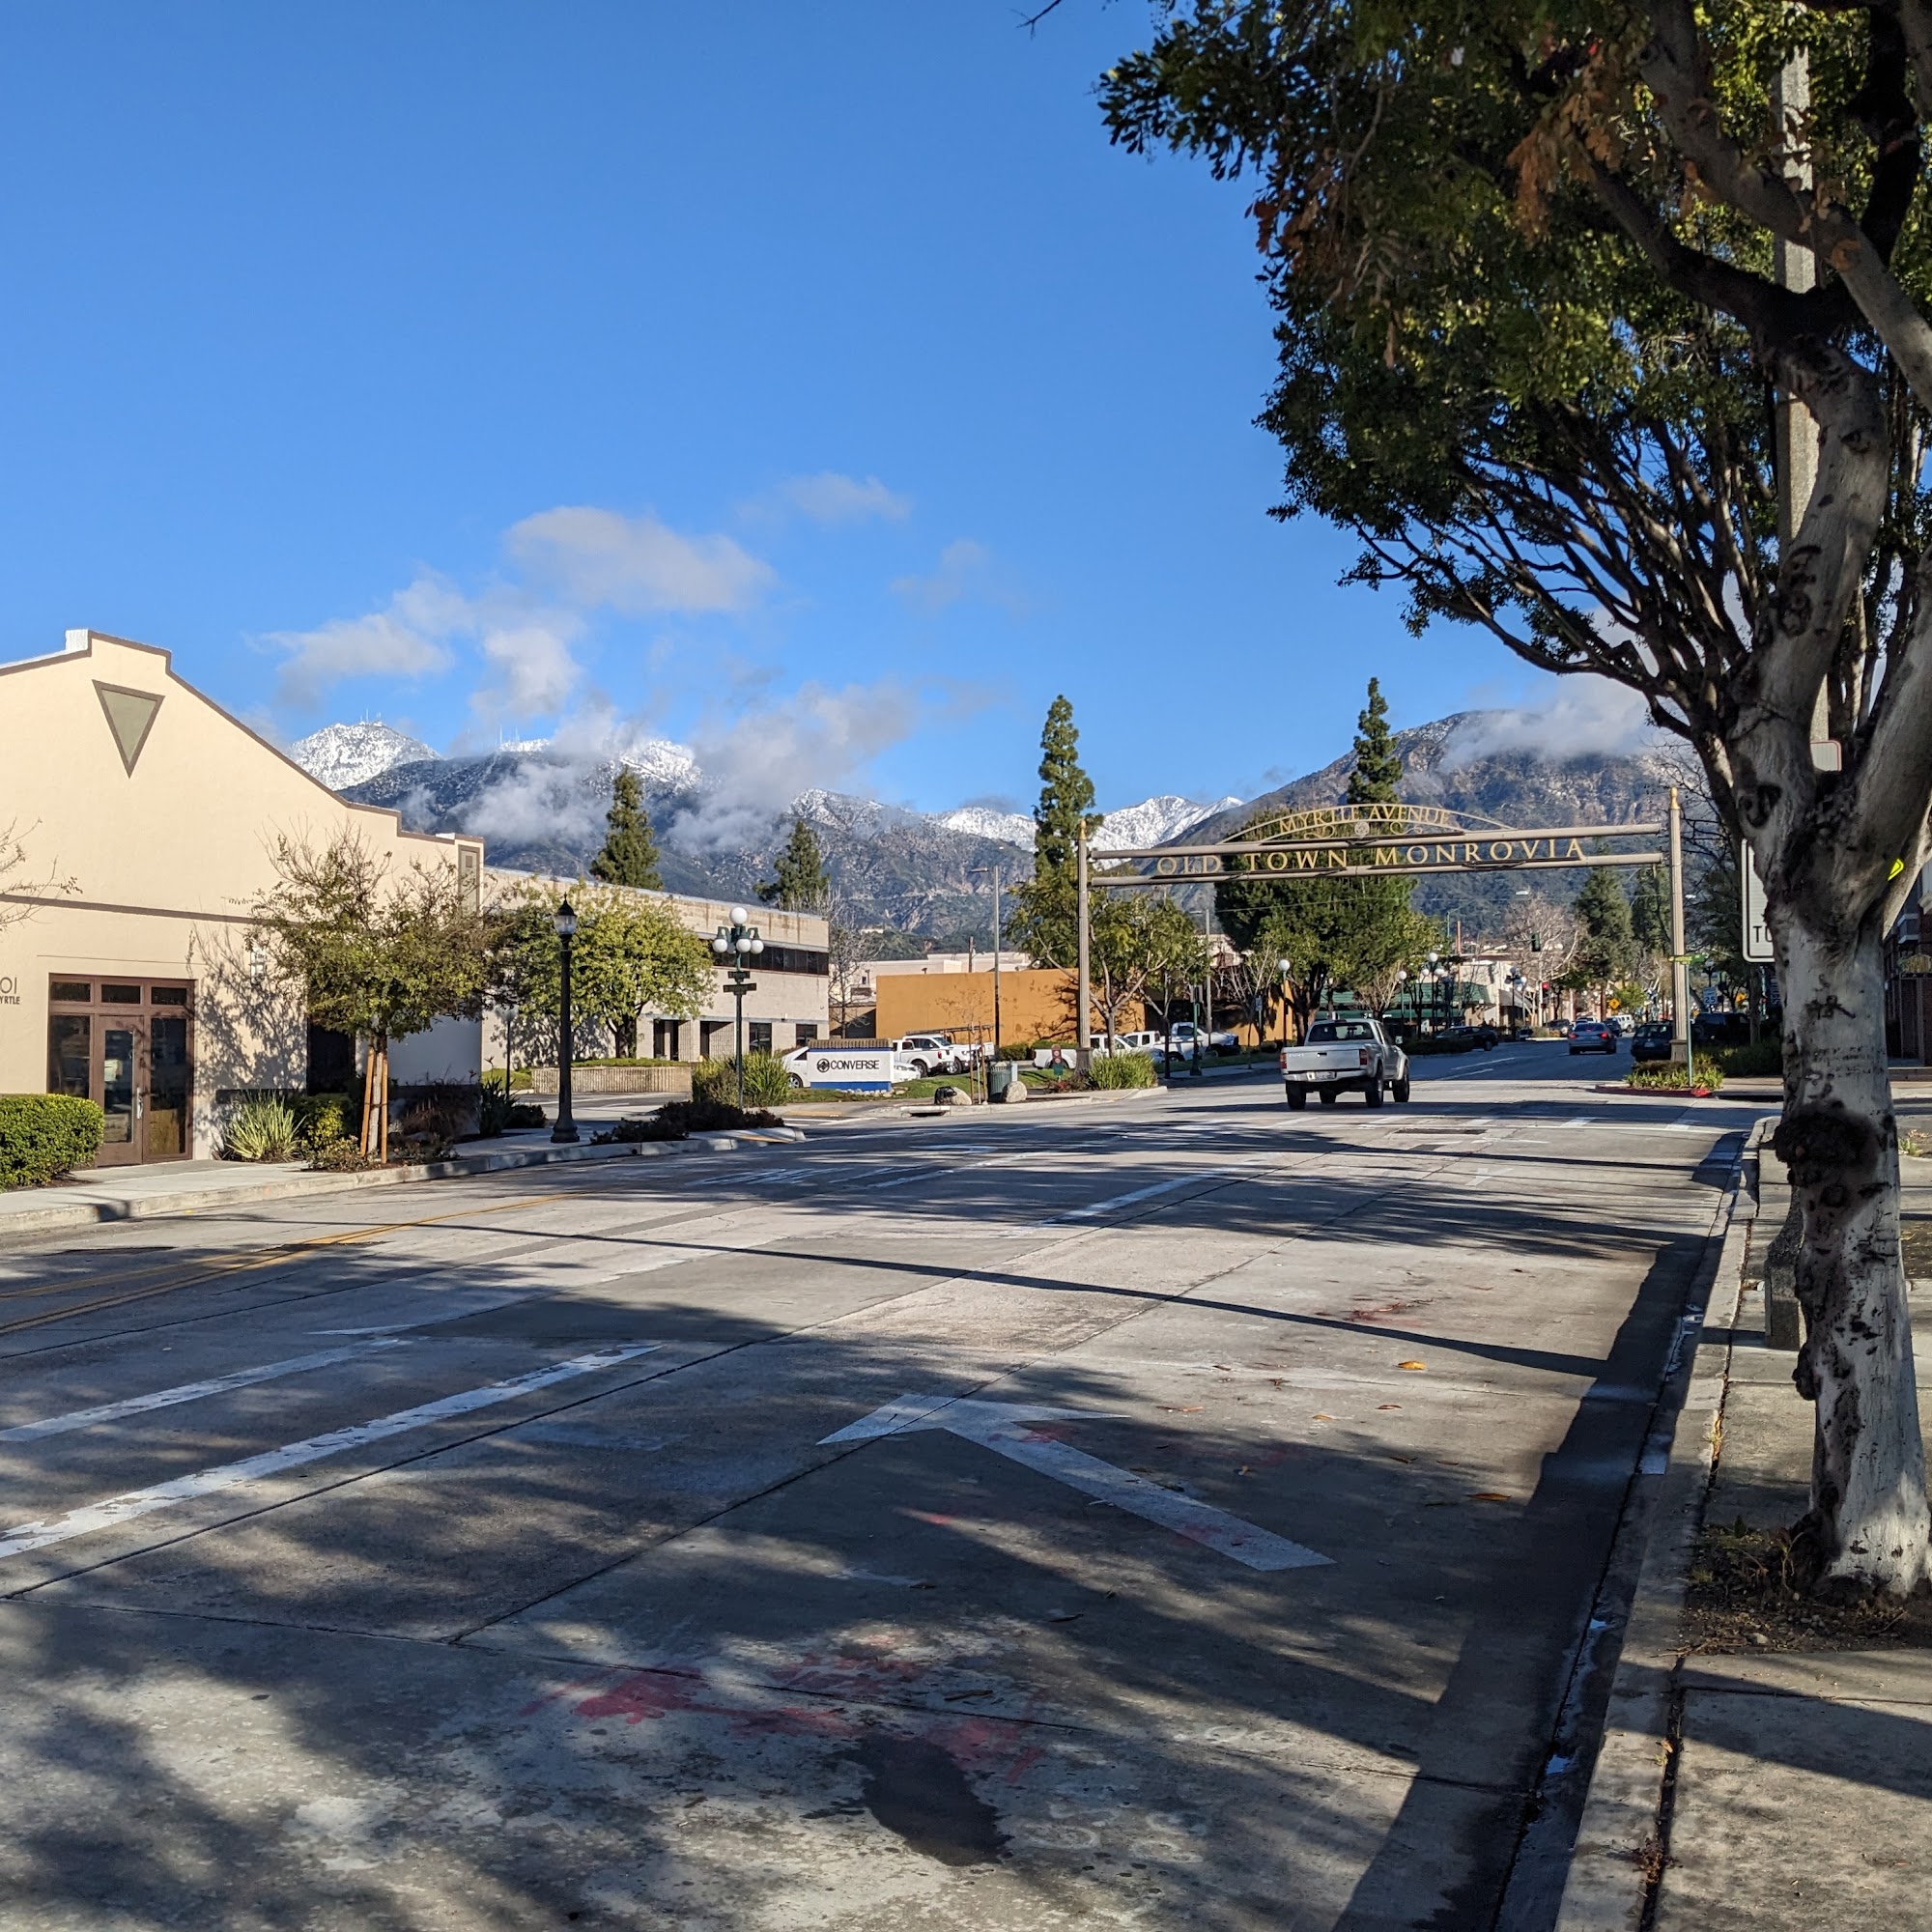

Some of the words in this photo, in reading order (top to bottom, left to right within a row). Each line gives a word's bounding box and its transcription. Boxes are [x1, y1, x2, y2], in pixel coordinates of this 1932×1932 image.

[1279, 806, 1360, 833] MYRTLE
[1370, 805, 1449, 825] AVENUE
[1157, 855, 1221, 875] OLD
[1244, 849, 1348, 871] TOWN
[1375, 838, 1585, 866] MONROVIA
[831, 1060, 880, 1070] CONVERSE
